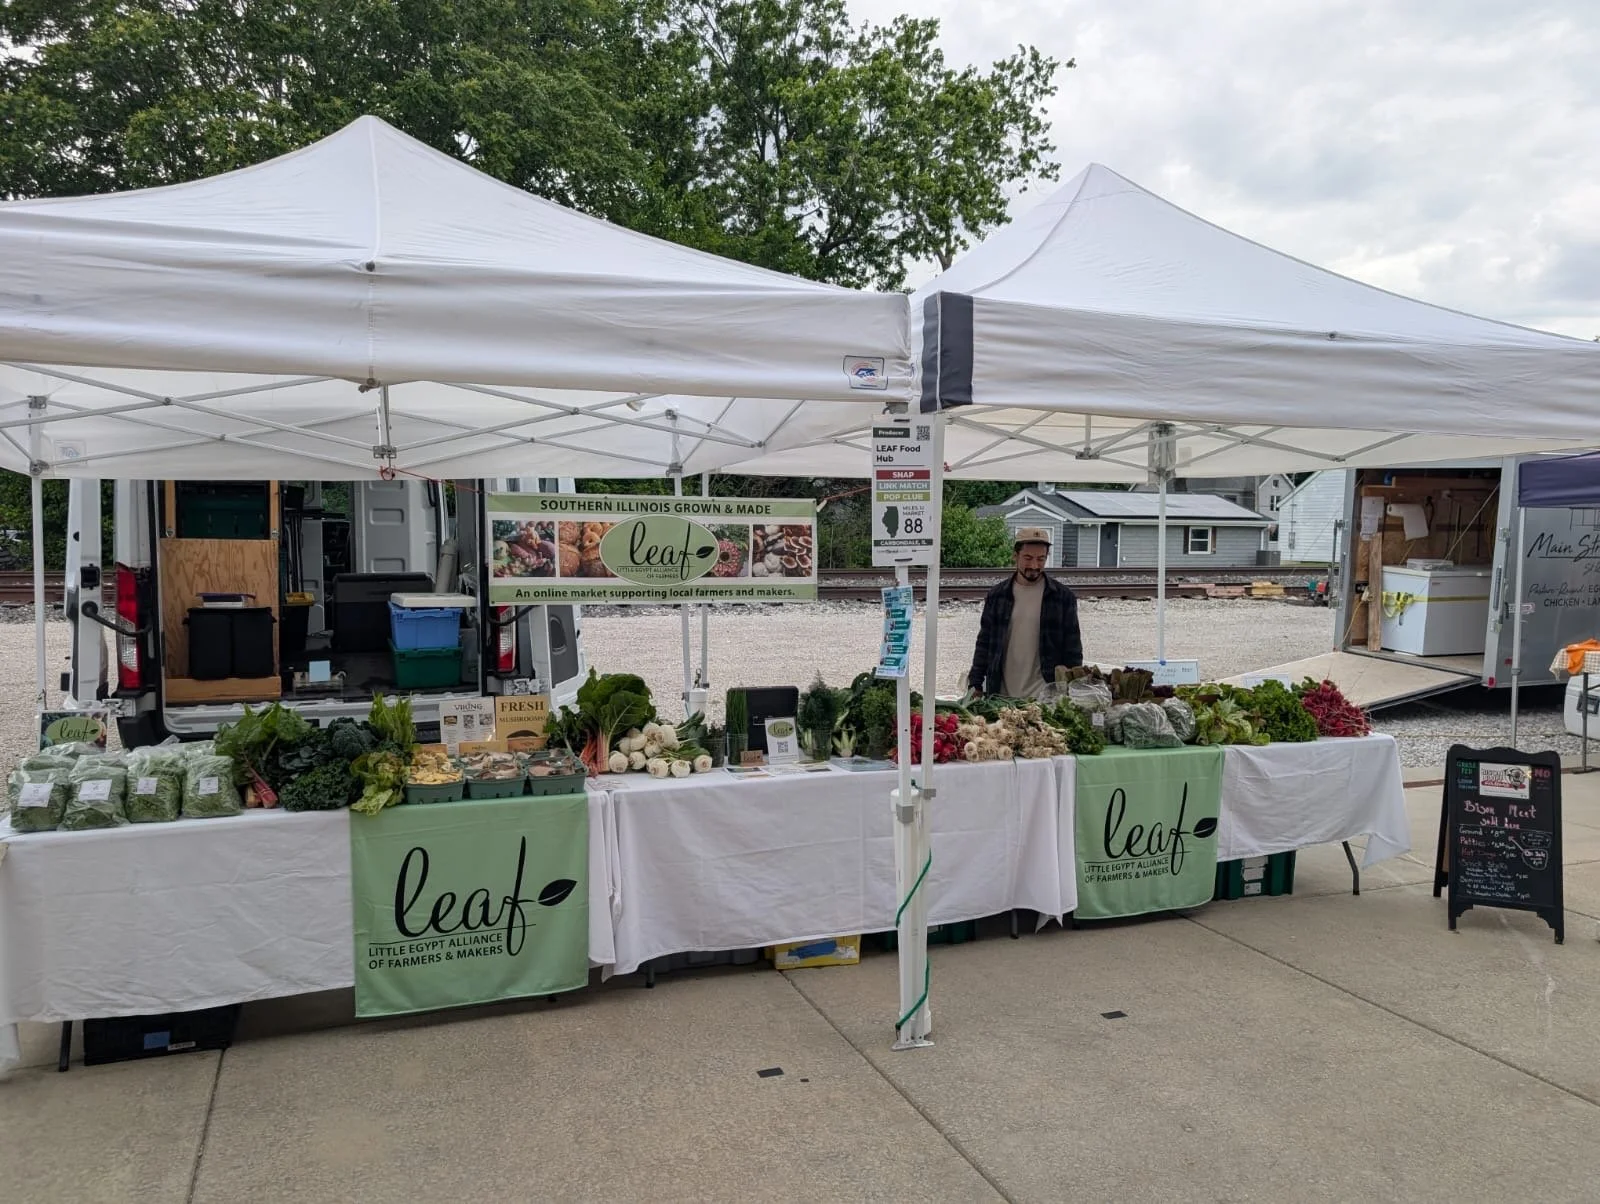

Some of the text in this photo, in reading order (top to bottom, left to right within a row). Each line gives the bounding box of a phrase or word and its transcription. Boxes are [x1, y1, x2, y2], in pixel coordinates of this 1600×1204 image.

[892, 471, 915, 479] SNAP
[900, 482, 928, 490] MATCH
[540, 499, 771, 515] SOUTHERN ILLINOIS GROWN & MADE
[904, 518, 923, 533] 88
[630, 521, 695, 580] leaf
[1527, 532, 1573, 558] Main
[515, 587, 796, 599] An online market supporting local farmers and makers.
[1543, 598, 1580, 608] CHICKEN
[454, 702, 484, 711] VIKING
[500, 701, 544, 712] FRESH
[1464, 800, 1536, 819] Bison Meat
[1104, 781, 1192, 876] leaf
[1084, 857, 1169, 873] LITTLE EGYPT ALLIANCE
[1085, 867, 1169, 883] OF FARMERS & MAKERS
[395, 836, 537, 956] leaf
[369, 933, 503, 957] LITTLE EGYPT ALLIANCE
[369, 944, 503, 970] OF FARMERS & MAKERS
